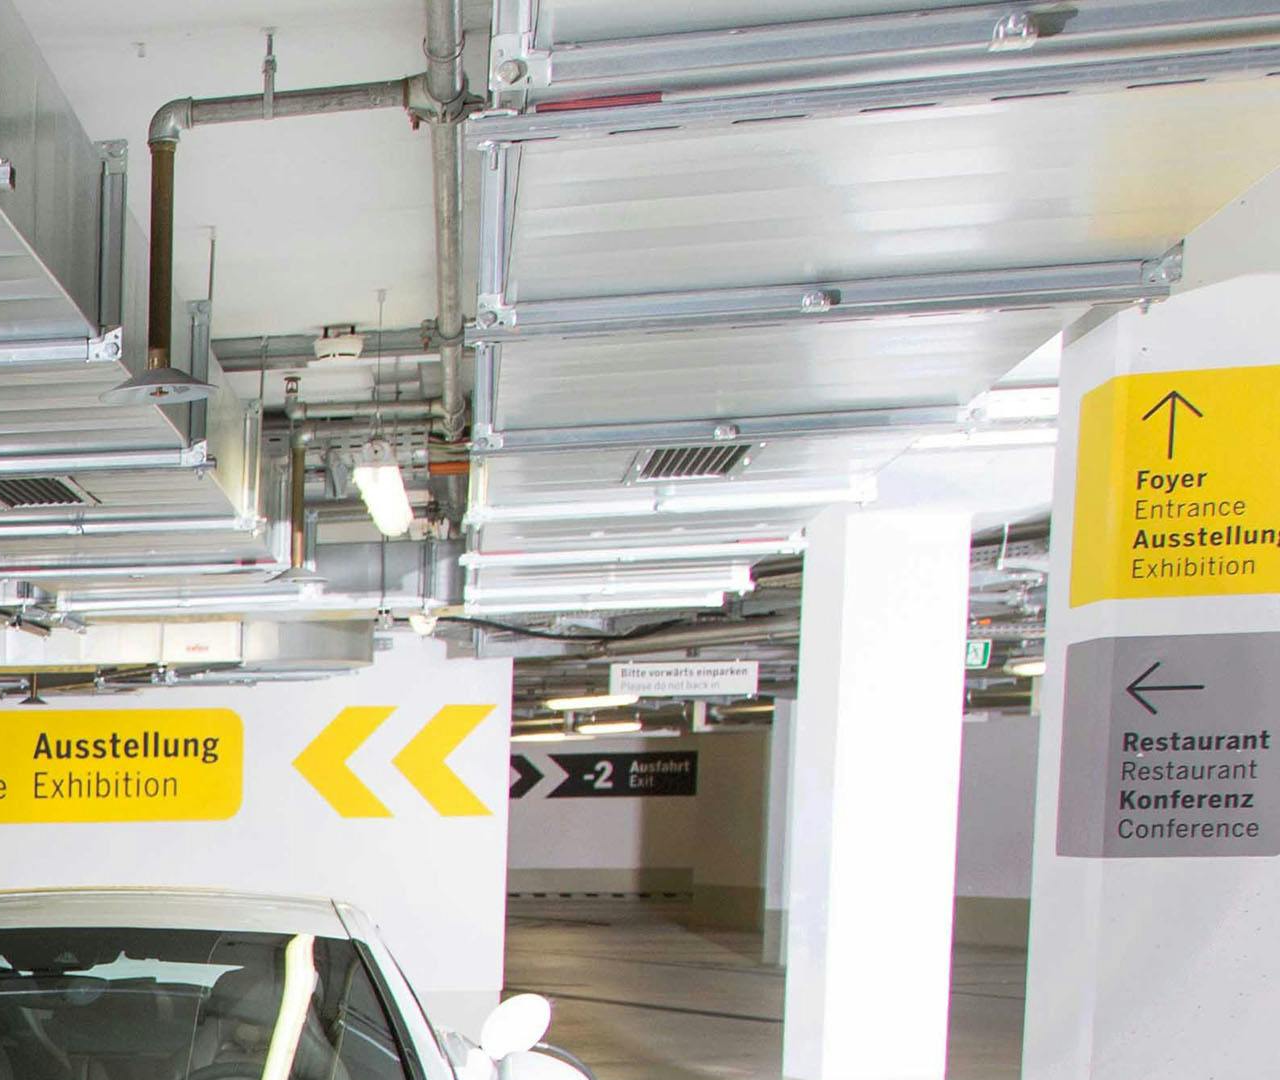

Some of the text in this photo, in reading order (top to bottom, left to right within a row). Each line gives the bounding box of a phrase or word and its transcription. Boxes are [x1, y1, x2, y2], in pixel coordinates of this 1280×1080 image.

[1136, 470, 1207, 494] Foyer
[1135, 500, 1246, 520] Entrance
[1131, 557, 1256, 579] Exhibition
[621, 668, 646, 678] Bitte
[697, 667, 748, 678] einparken
[33, 732, 220, 764] Ausstellung
[1122, 730, 1270, 752] Restaurant
[583, 759, 690, 790] -2 Ausfahrt
[629, 775, 655, 788] Exit
[1121, 760, 1258, 781] Restaurant
[34, 771, 178, 799] Exhibition
[1119, 789, 1254, 811] Konferenz
[1118, 818, 1260, 840] Conference
